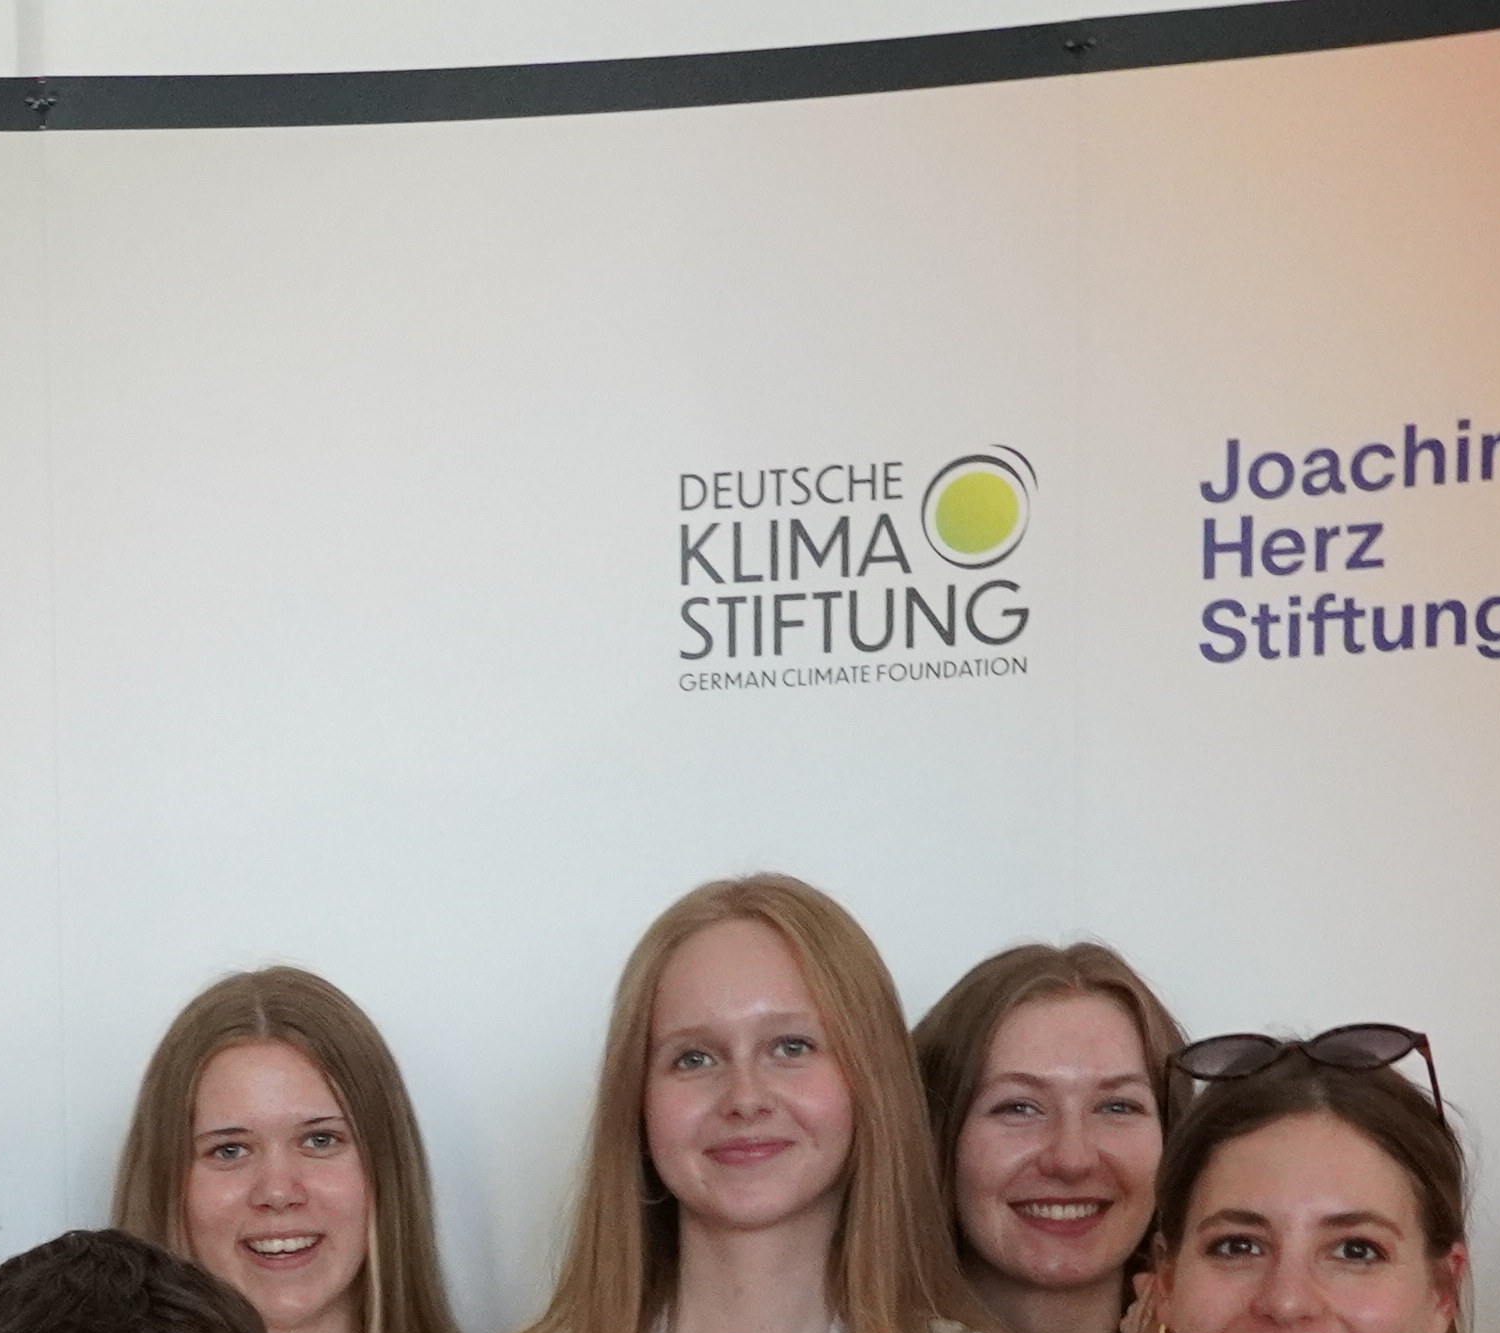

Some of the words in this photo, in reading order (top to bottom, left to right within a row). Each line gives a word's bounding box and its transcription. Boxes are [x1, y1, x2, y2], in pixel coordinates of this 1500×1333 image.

[680, 461, 904, 511] DEUTSCHE
[680, 513, 913, 586] KLIMA
[1202, 514, 1385, 581] Herz
[679, 579, 1031, 660] STIFTUNG
[679, 668, 776, 692] GERMAN
[781, 664, 871, 688] CLIMATE
[876, 656, 1029, 683] FOUNDATION
